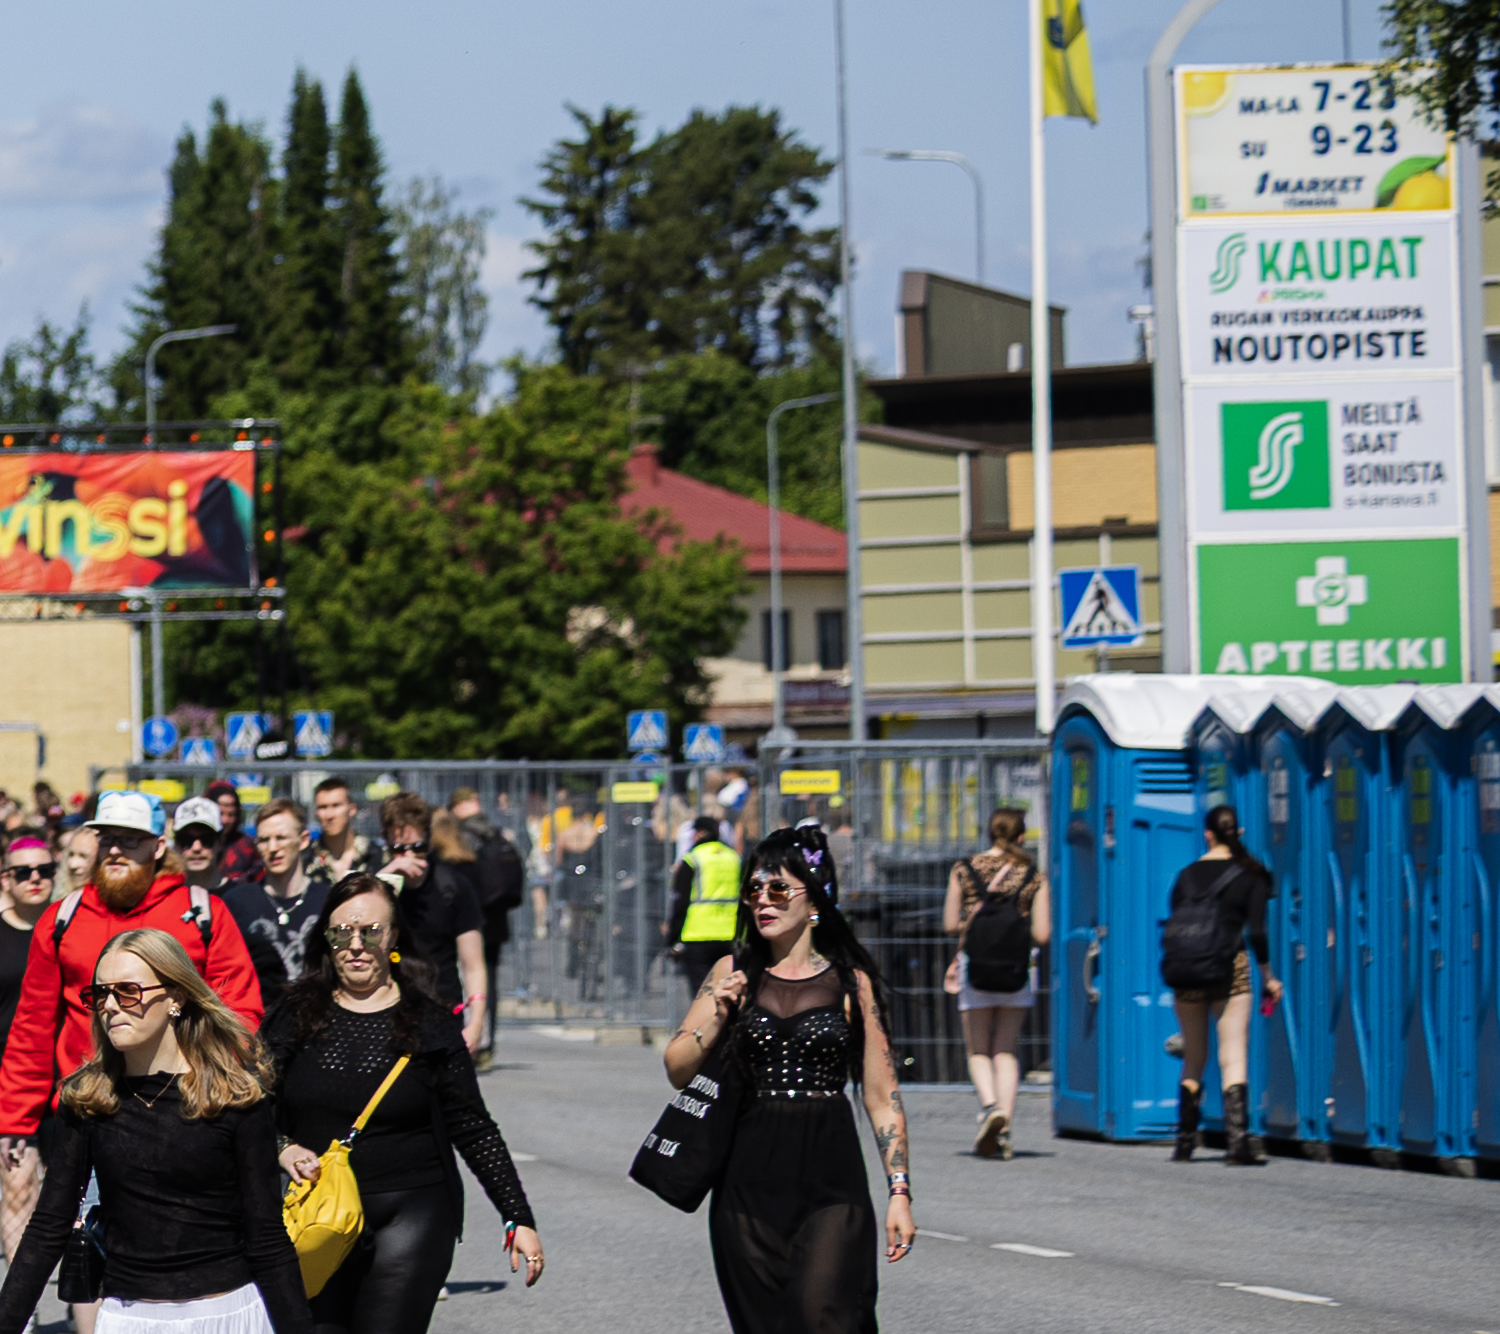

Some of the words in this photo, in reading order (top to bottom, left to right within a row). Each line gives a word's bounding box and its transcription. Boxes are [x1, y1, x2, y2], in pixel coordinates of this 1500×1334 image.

[1240, 141, 1266, 158] SU
[1311, 123, 1398, 156] 9-23
[1270, 176, 1365, 195] MARKET
[1257, 235, 1423, 284] KAUPAT
[1213, 330, 1426, 364] NOUTOPISTE
[1342, 397, 1422, 425] MEILTÄ
[1343, 432, 1400, 455] SAAT
[1343, 463, 1447, 487] BONUSTA
[1215, 637, 1447, 674] APTEEKKI
